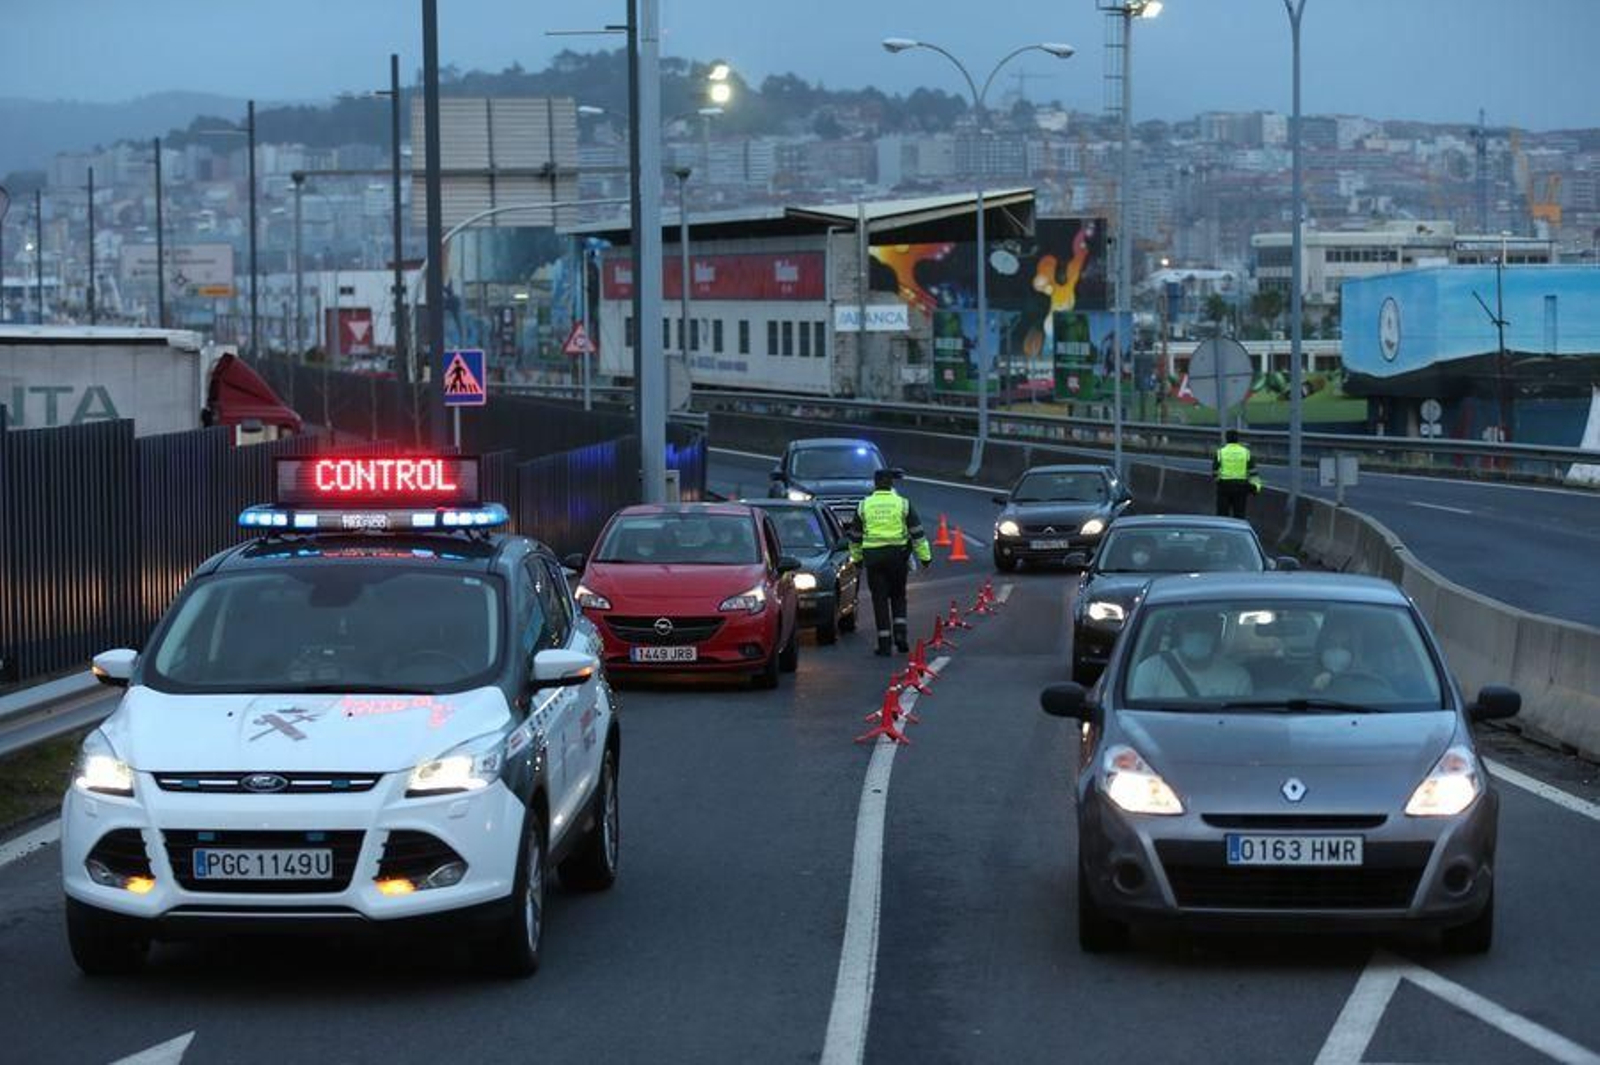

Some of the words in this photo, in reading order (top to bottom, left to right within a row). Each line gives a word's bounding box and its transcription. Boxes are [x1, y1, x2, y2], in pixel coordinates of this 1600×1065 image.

[315, 459, 457, 491] CONTROL
[638, 648, 668, 660] 1449
[1240, 839, 1302, 861] 0163
[1311, 839, 1356, 861] HMR
[206, 853, 331, 876] PGC1149U
